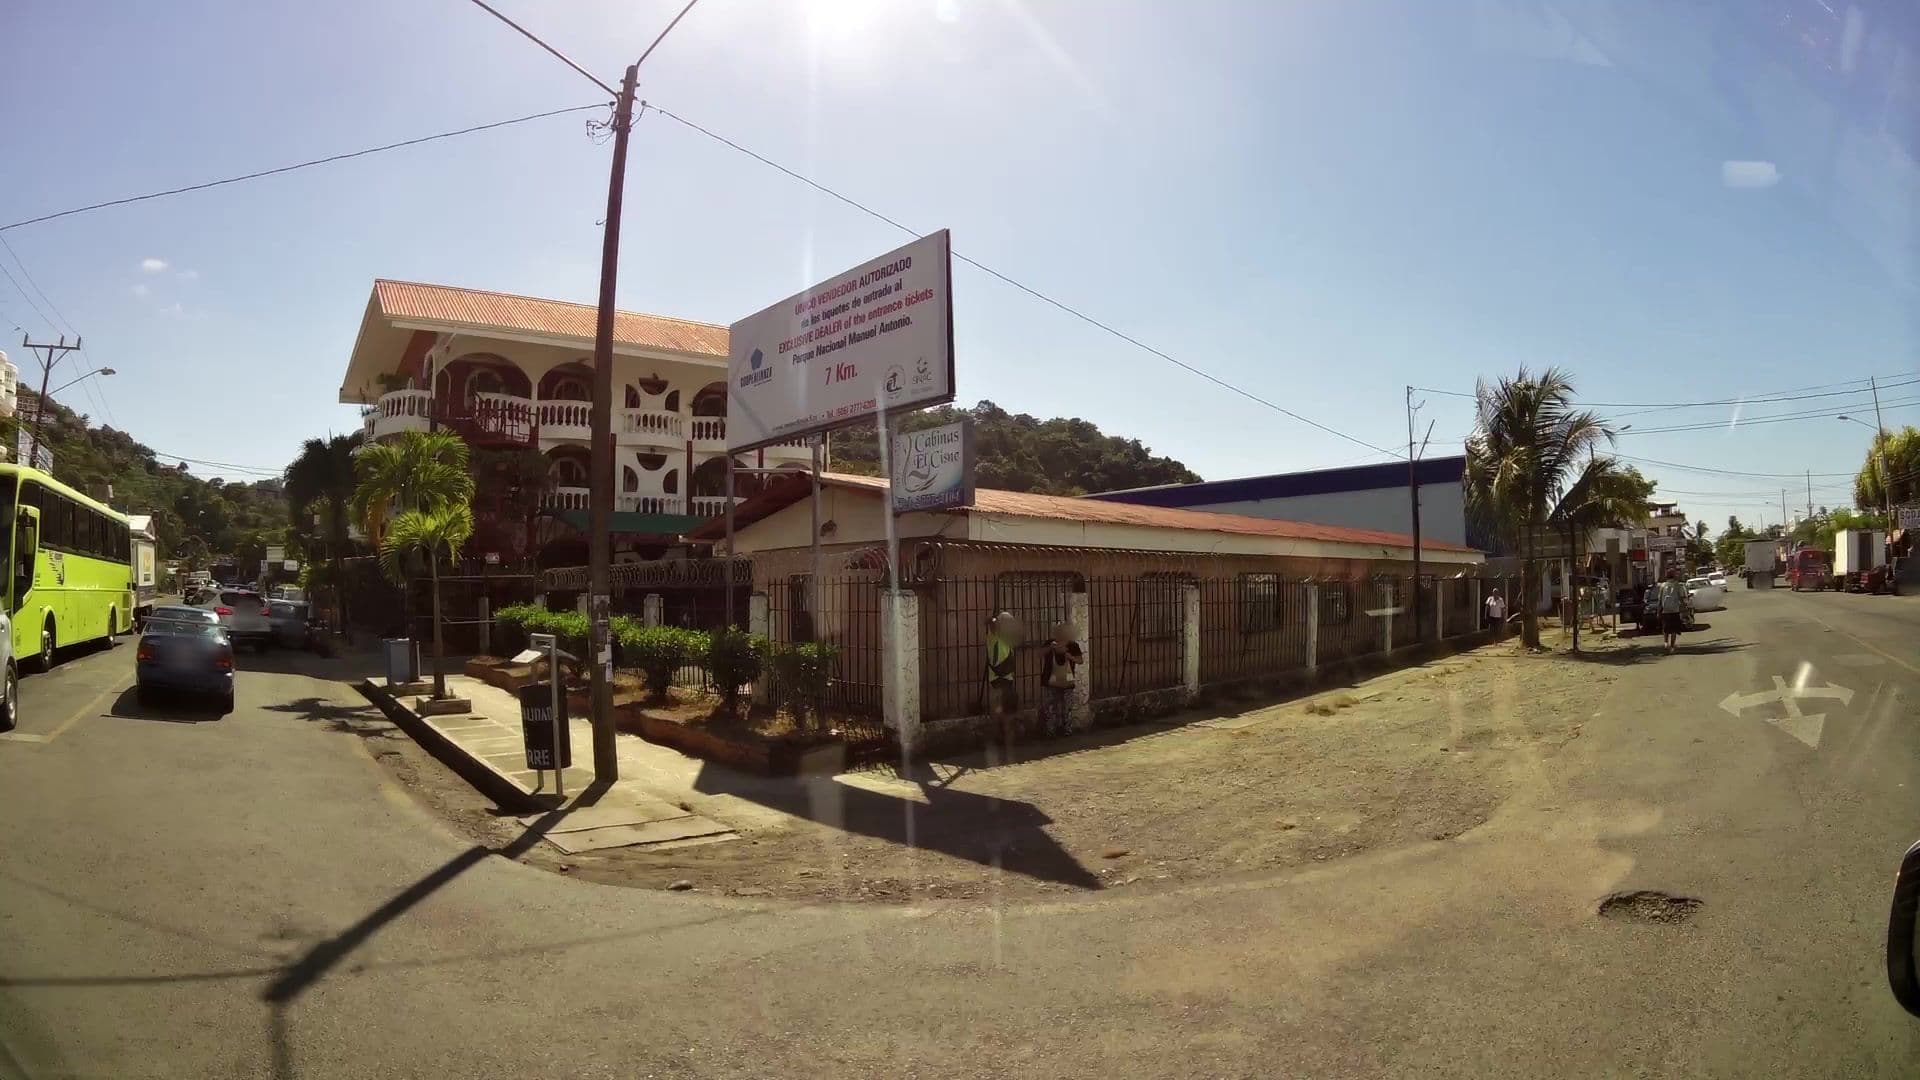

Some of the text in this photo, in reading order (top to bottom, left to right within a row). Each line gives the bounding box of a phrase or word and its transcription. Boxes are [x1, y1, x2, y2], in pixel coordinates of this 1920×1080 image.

[811, 313, 820, 325] los
[852, 296, 861, 309] de
[863, 285, 892, 304] entrada
[894, 278, 902, 292] al
[817, 280, 858, 306] VENDEDOR
[859, 256, 912, 288] AUTORIZADO
[778, 288, 934, 354] EXCLUSIVE DEALER of the entrance tickets
[792, 314, 913, 365] Parque Nacional Manuel Antonio.
[825, 361, 857, 385] 7 Km.
[913, 450, 960, 469] El Cisne
[914, 430, 959, 452] Cabinas
